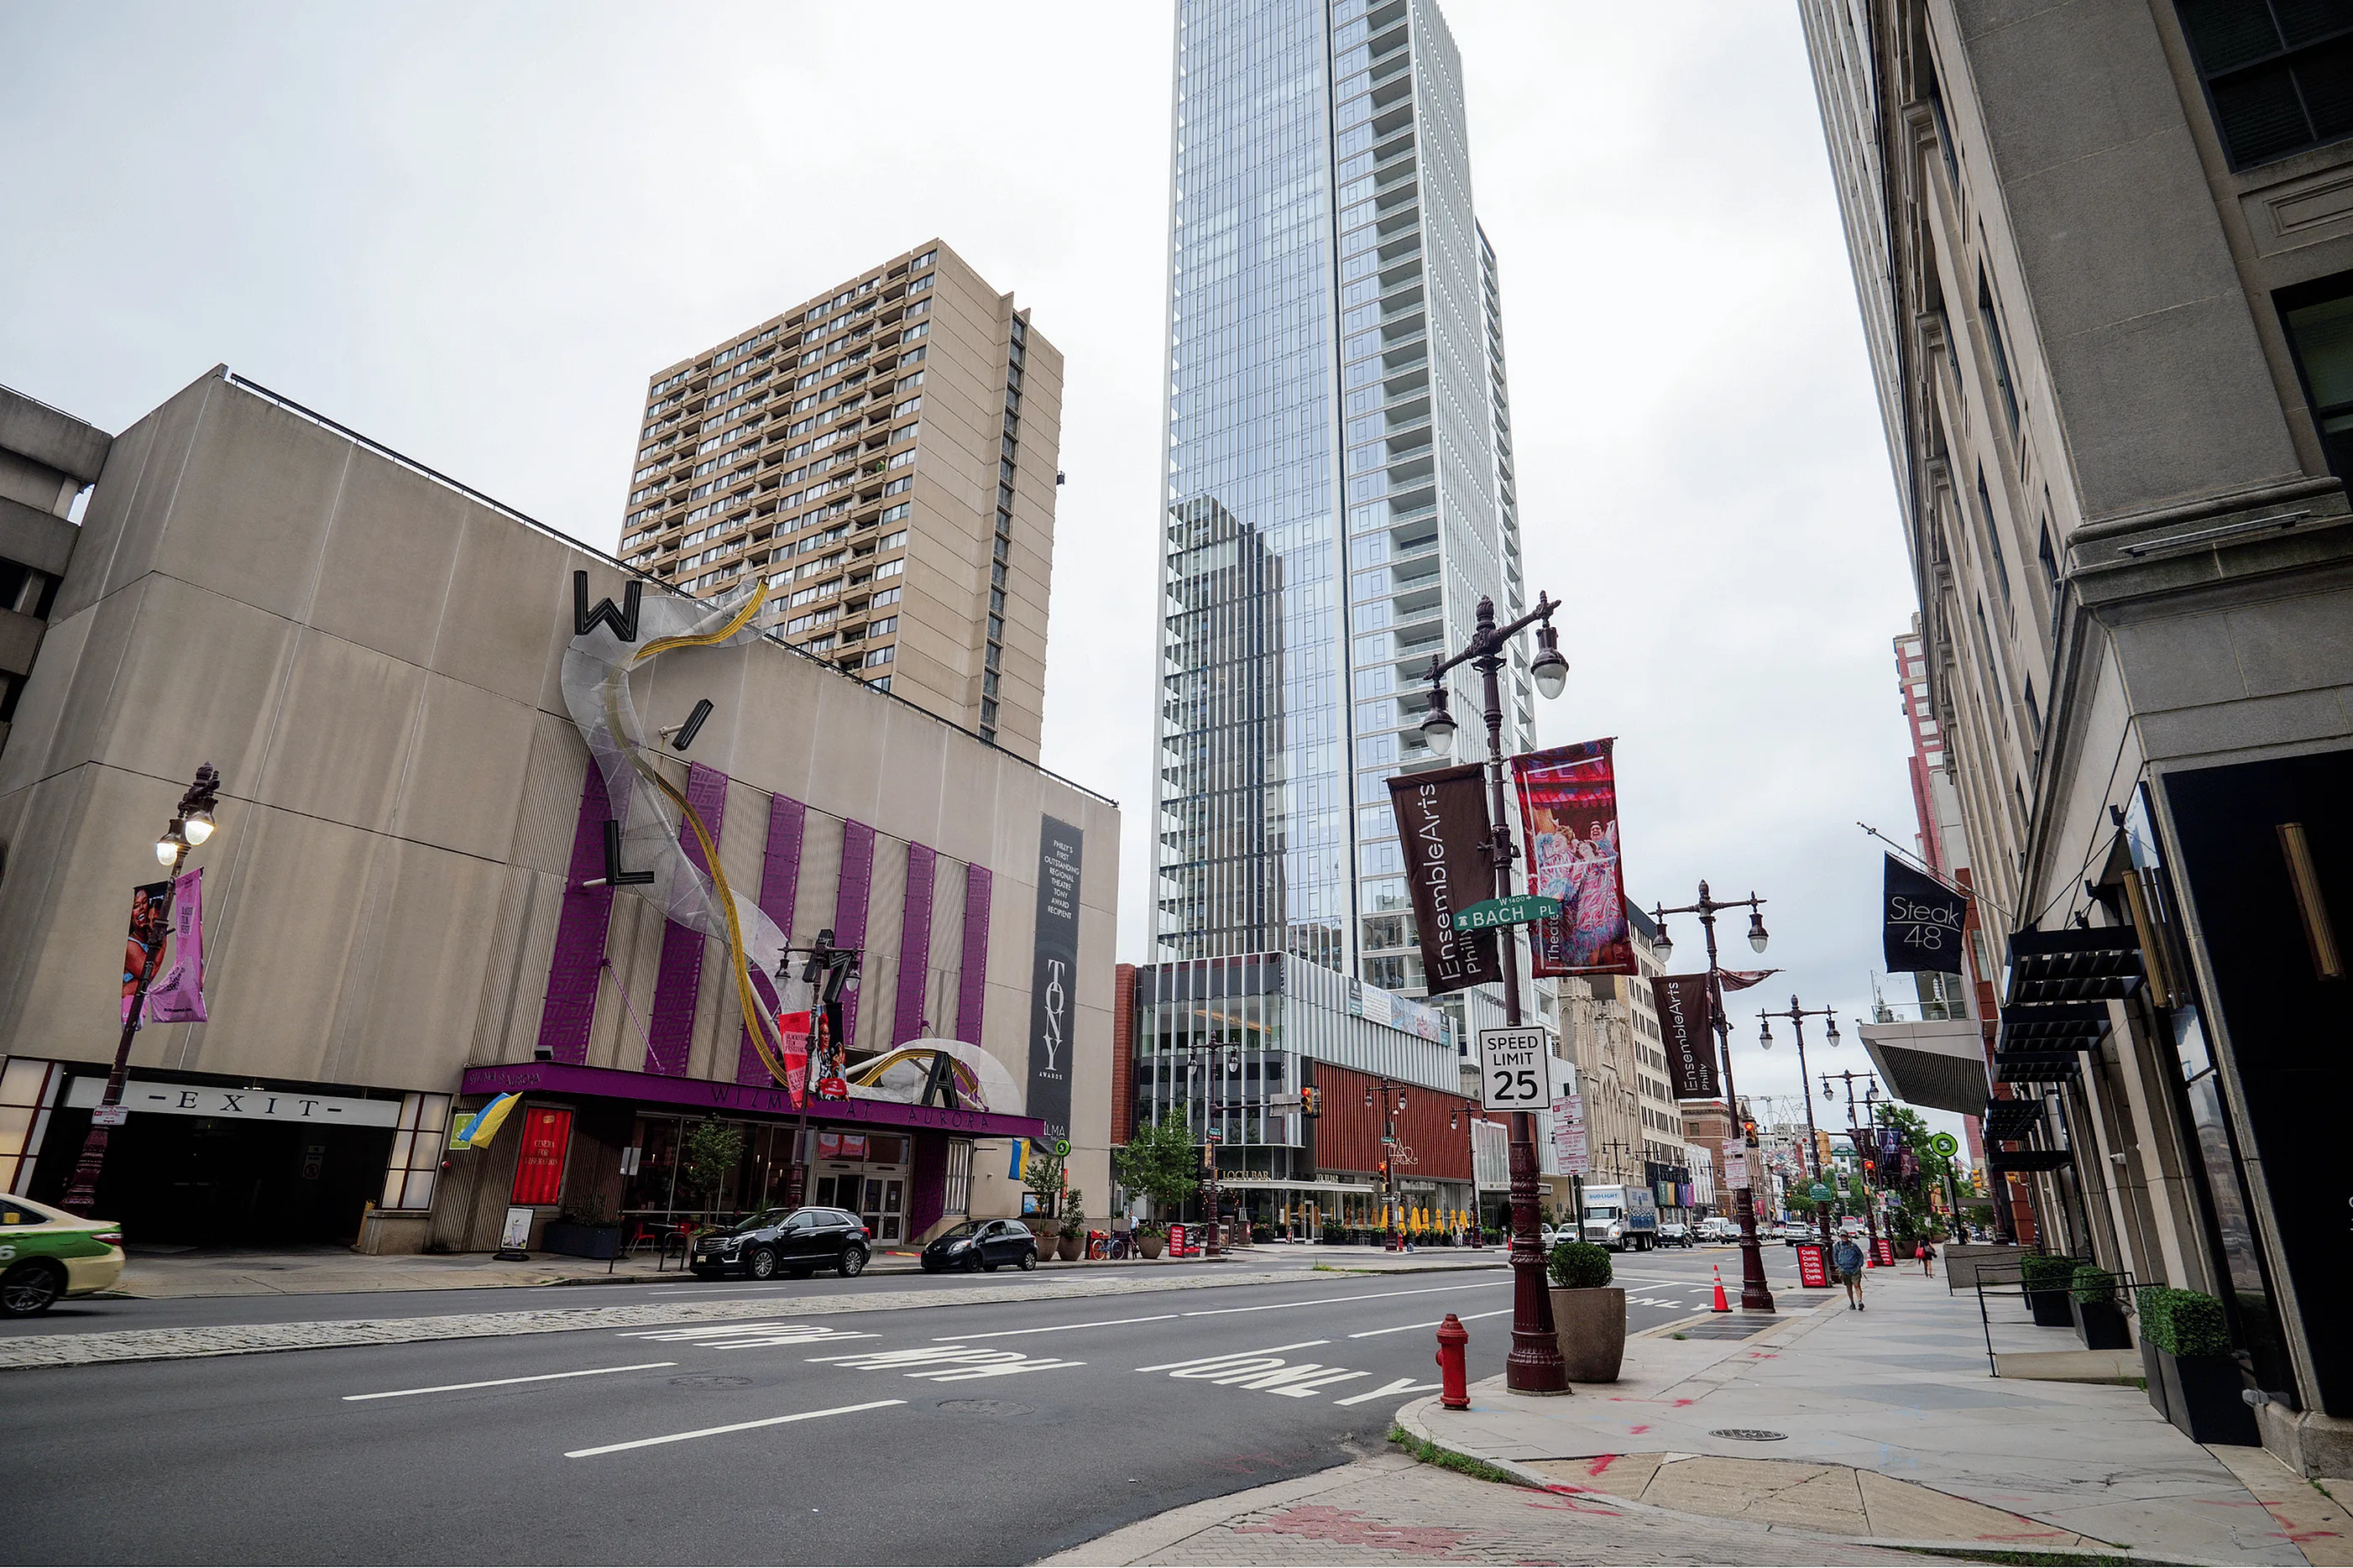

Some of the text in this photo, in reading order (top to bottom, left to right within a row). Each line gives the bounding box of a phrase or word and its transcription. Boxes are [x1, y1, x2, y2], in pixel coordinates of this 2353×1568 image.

[1054, 839, 1074, 854] PHILLY'S
[1056, 850, 1069, 861] FIRST
[1043, 855, 1080, 875] OUTSTANDING
[1049, 866, 1075, 883] REGIONAL
[1418, 782, 1461, 980] EnsembleArts
[1051, 877, 1072, 891] THEATRE
[1054, 888, 1068, 899] TONY
[1498, 896, 1525, 907] W 1400
[1051, 897, 1069, 909] AWARD
[1539, 904, 1556, 917] PL
[1890, 896, 1959, 928] Steak
[1048, 905, 1072, 920] RECIPIENT
[1472, 905, 1524, 927] BACH
[1547, 913, 1561, 962] Theate
[1903, 925, 1942, 949] 48
[1459, 929, 1482, 975] Philly
[1043, 959, 1065, 1071] TONY
[1488, 1036, 1538, 1050] SPEED
[1667, 981, 1698, 1091] EnsembleArts
[1493, 1053, 1534, 1066] LIMIT
[1038, 1071, 1063, 1080] AWARDS
[1699, 1064, 1710, 1090] Philly
[1493, 1070, 1538, 1100] 25
[845, 1101, 872, 1118] AT
[908, 1107, 990, 1129] AURORA
[1222, 1170, 1270, 1181] LOCH BAR
[1169, 1357, 1443, 1406] ONLY
